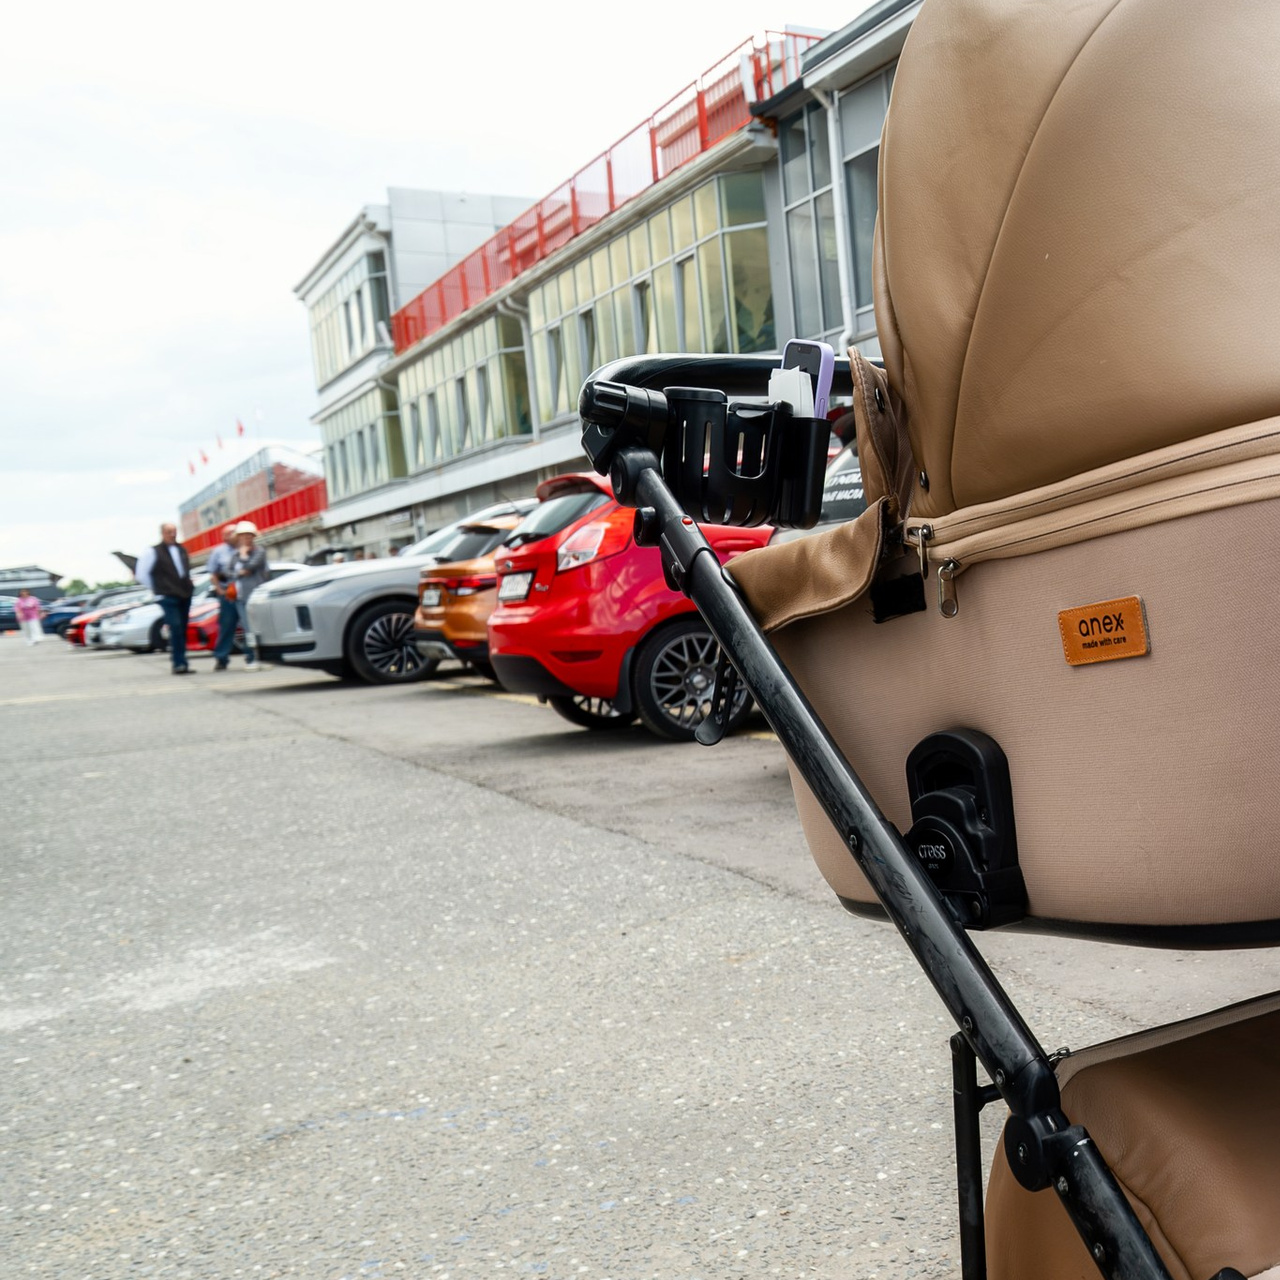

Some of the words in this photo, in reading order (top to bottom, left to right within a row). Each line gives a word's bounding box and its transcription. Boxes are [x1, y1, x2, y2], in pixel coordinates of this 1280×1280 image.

[1079, 612, 1124, 637] anex
[1083, 640, 1098, 649] made
[1100, 637, 1112, 646] with
[1113, 636, 1126, 645] care
